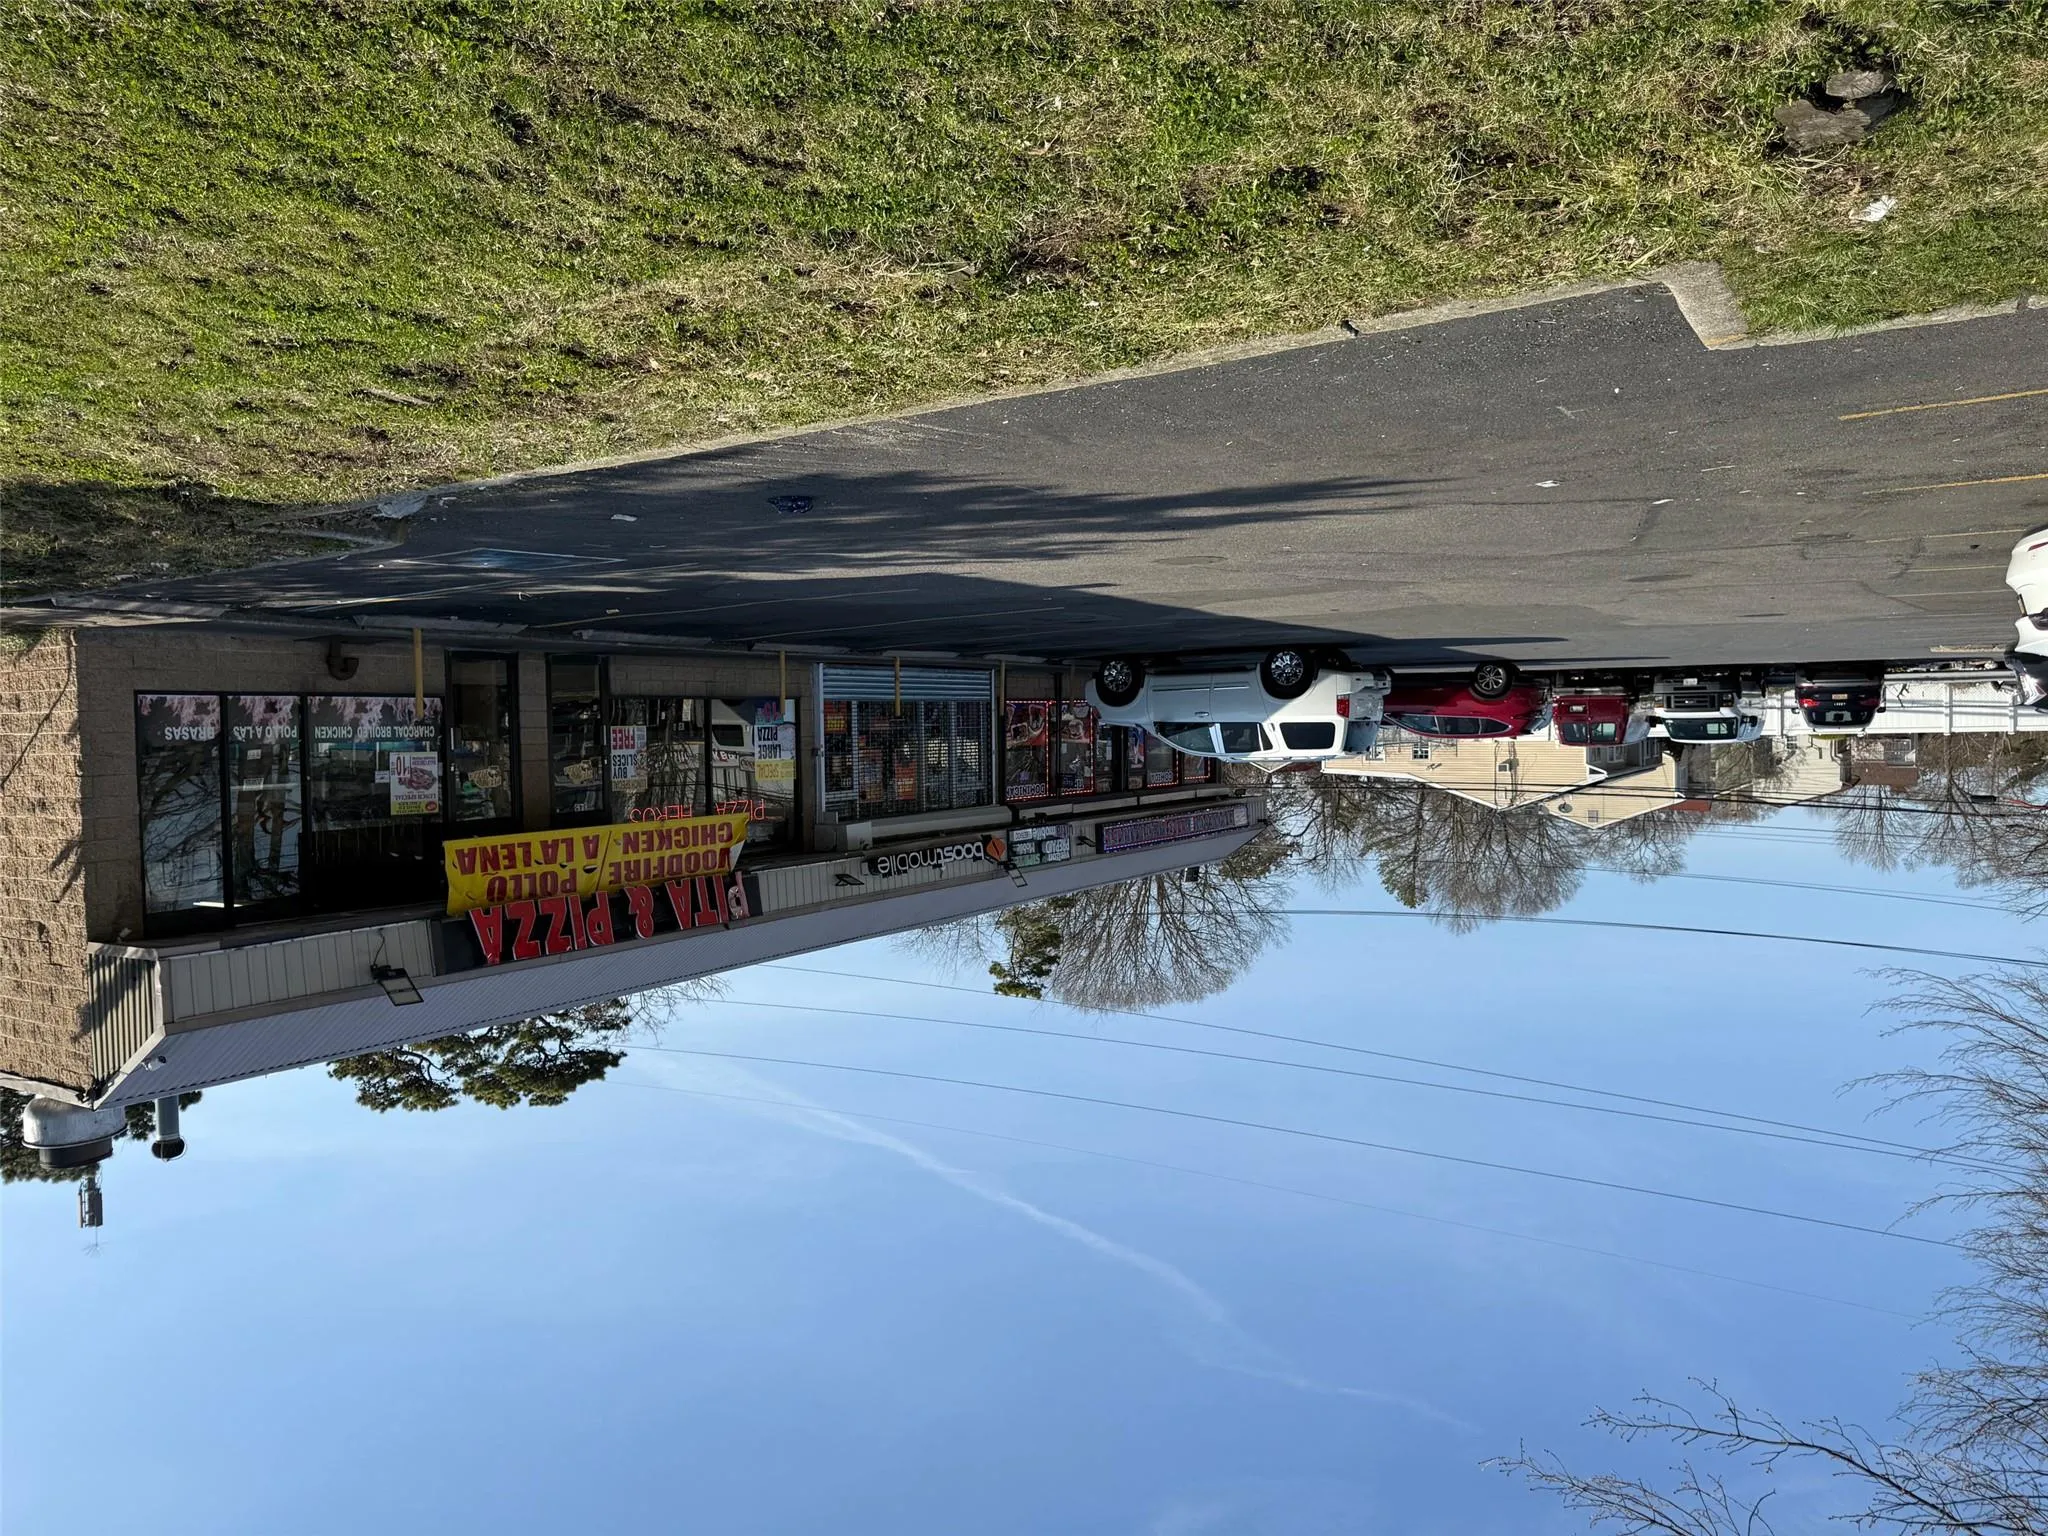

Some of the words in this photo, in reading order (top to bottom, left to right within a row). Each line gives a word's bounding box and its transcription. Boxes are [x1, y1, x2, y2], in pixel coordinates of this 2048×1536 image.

[233, 726, 253, 739] LAS
[255, 726, 263, 738] A
[265, 726, 297, 738] POLLO
[314, 726, 353, 738] CHICKEN
[357, 726, 392, 738] BROILED
[393, 726, 435, 738] CHARCOAL
[612, 728, 635, 750] FREE
[757, 726, 777, 741] PIZZA
[758, 744, 781, 759] LARGE
[612, 753, 637, 766] SLICES
[612, 767, 627, 779] BUY
[622, 822, 733, 854] CHICKEN
[539, 837, 574, 865] LA
[582, 834, 600, 860] A
[455, 840, 532, 878] LEÑA
[486, 868, 577, 903] POLLO
[664, 871, 750, 930] PITA
[624, 884, 654, 939] &
[468, 891, 614, 966] PIZZA
